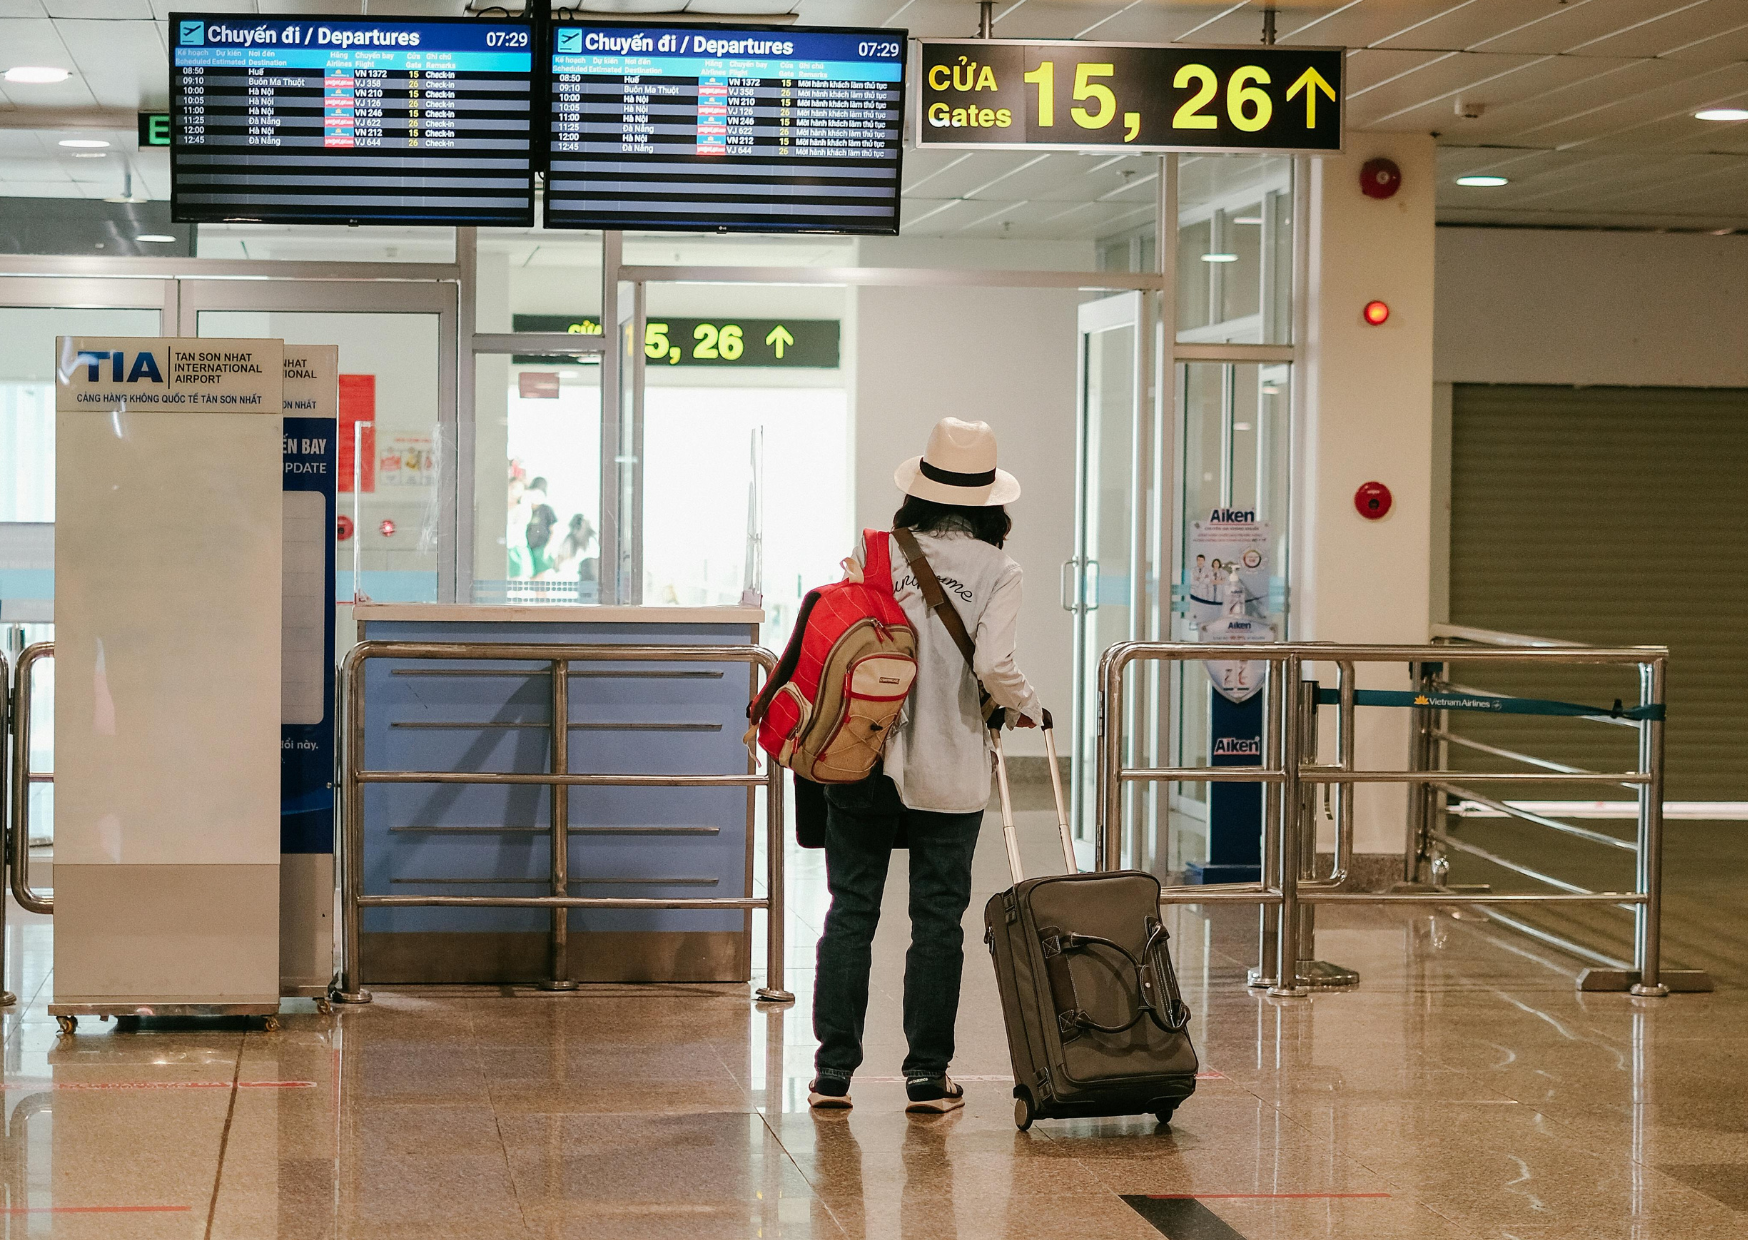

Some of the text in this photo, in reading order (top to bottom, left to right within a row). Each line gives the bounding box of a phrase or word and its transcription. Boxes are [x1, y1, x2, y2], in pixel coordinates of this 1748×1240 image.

[208, 24, 420, 48] Chuyến đi / Departures
[486, 32, 528, 47] 07:29
[585, 33, 793, 57] Chuyến đi / Departures
[858, 42, 899, 57] 07:29
[928, 56, 998, 92] CỬA
[1024, 61, 1273, 143] 15, 26
[928, 103, 1011, 128] Gates
[692, 324, 744, 360] 26
[175, 352, 252, 362] TAN SON NHAT
[78, 351, 163, 382] TIA
[174, 363, 262, 373] INTERNATIONAL
[175, 374, 221, 384] AIRPORT
[77, 392, 100, 403] CẢNG
[130, 393, 159, 403] KHÔNG
[162, 392, 186, 404] QUỐC
[188, 392, 199, 404] TẾ
[201, 393, 218, 404] TÂN
[220, 394, 238, 404] SƠN
[240, 393, 262, 405] NHẤT
[295, 400, 316, 409] NHẤT
[302, 438, 326, 454] BAY
[284, 462, 326, 473] PDATE
[1210, 509, 1254, 523] Aiken
[1429, 698, 1490, 708] Vietnam Airlines
[297, 740, 318, 751] này.
[1214, 738, 1260, 753] Aiken
